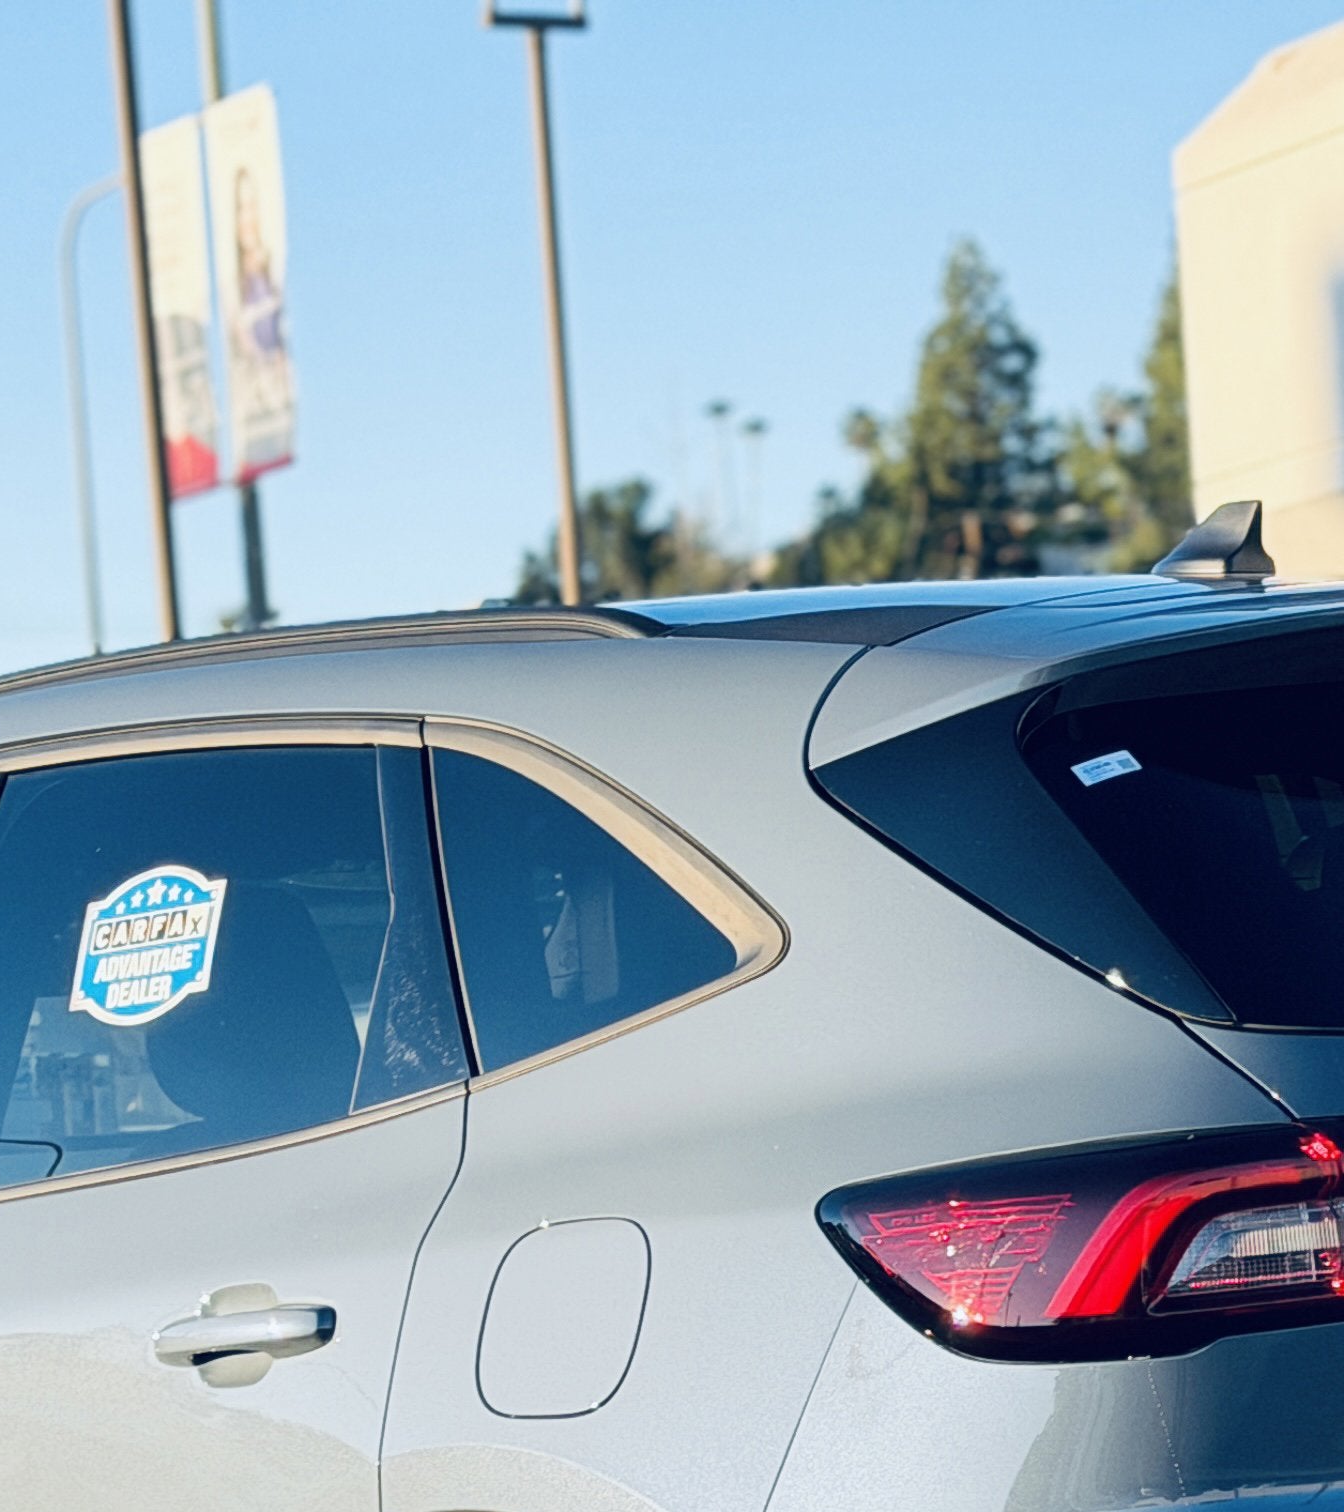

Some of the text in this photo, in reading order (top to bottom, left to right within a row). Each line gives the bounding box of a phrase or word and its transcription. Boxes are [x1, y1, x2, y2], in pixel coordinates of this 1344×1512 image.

[94, 911, 203, 950] CARFAX
[92, 943, 201, 984] ADVANTAGE
[105, 975, 172, 1009] DEALER
